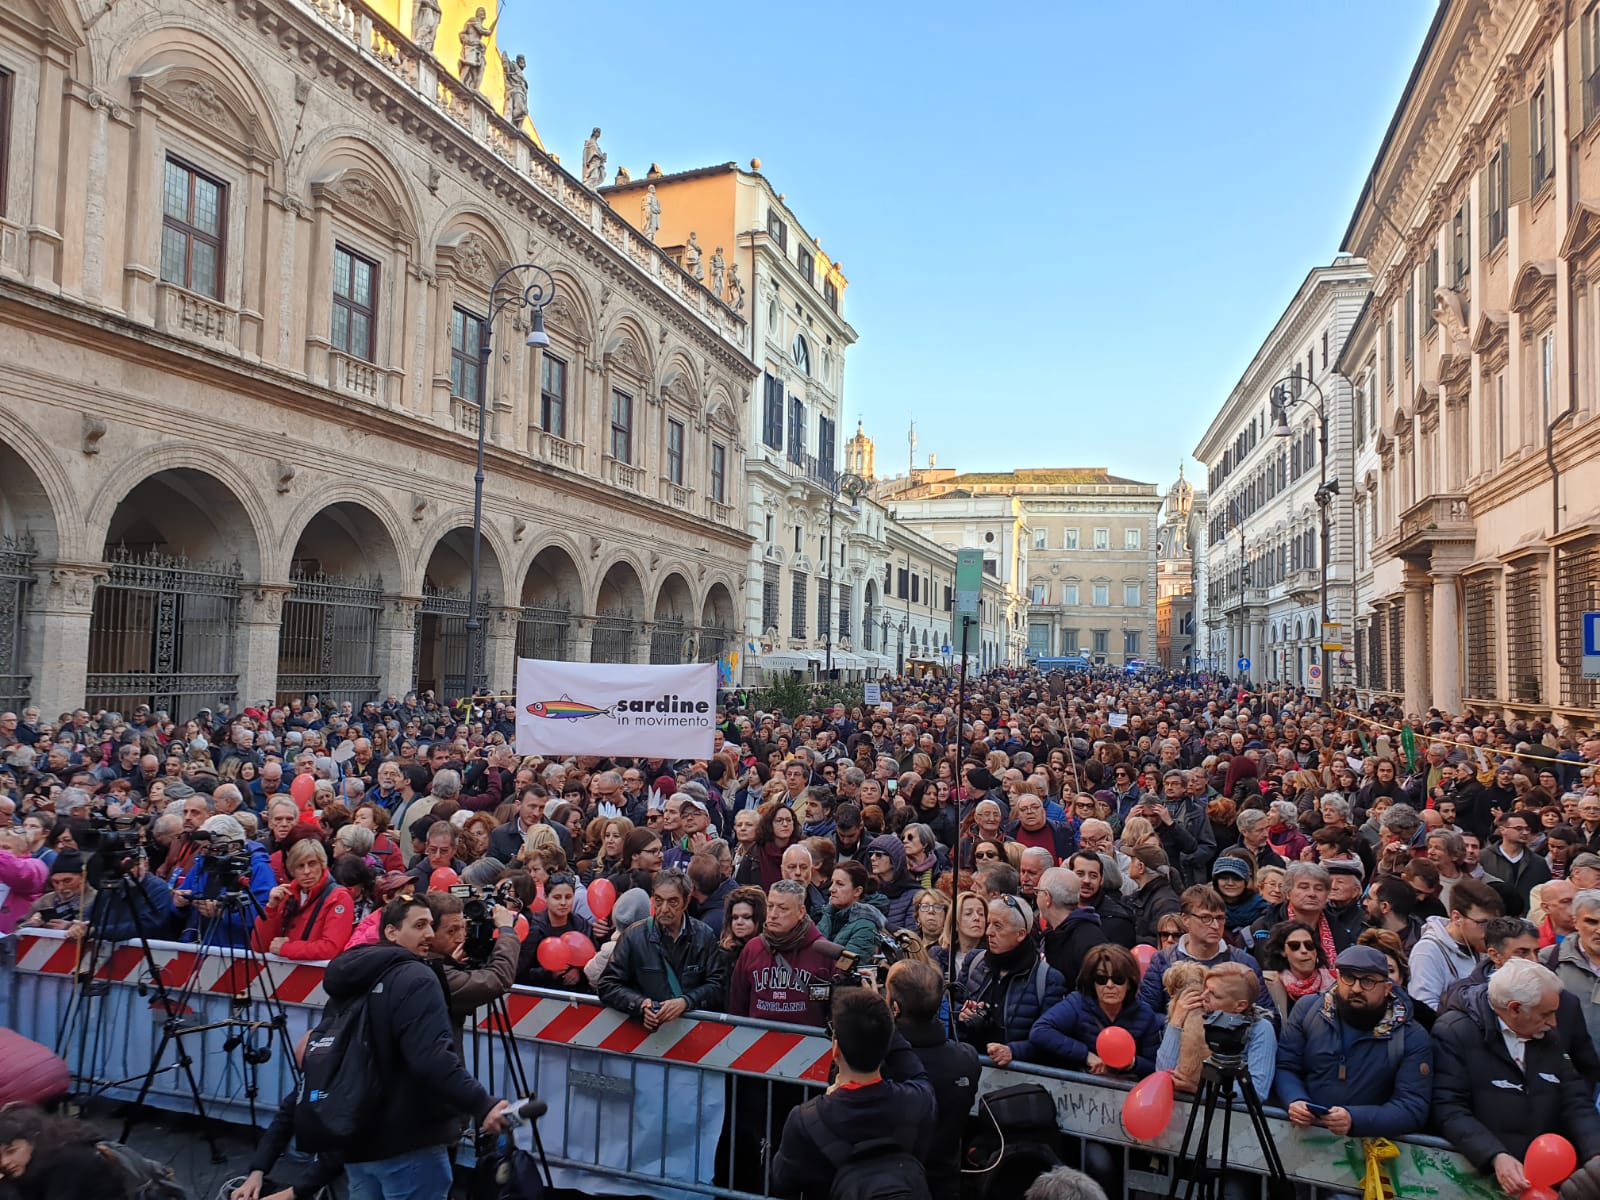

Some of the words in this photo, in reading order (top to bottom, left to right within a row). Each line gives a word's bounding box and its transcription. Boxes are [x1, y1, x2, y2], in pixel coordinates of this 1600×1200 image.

[617, 695, 709, 713] sardine
[617, 715, 629, 726] in
[635, 715, 709, 727] movimento
[753, 966, 811, 992] LONDON
